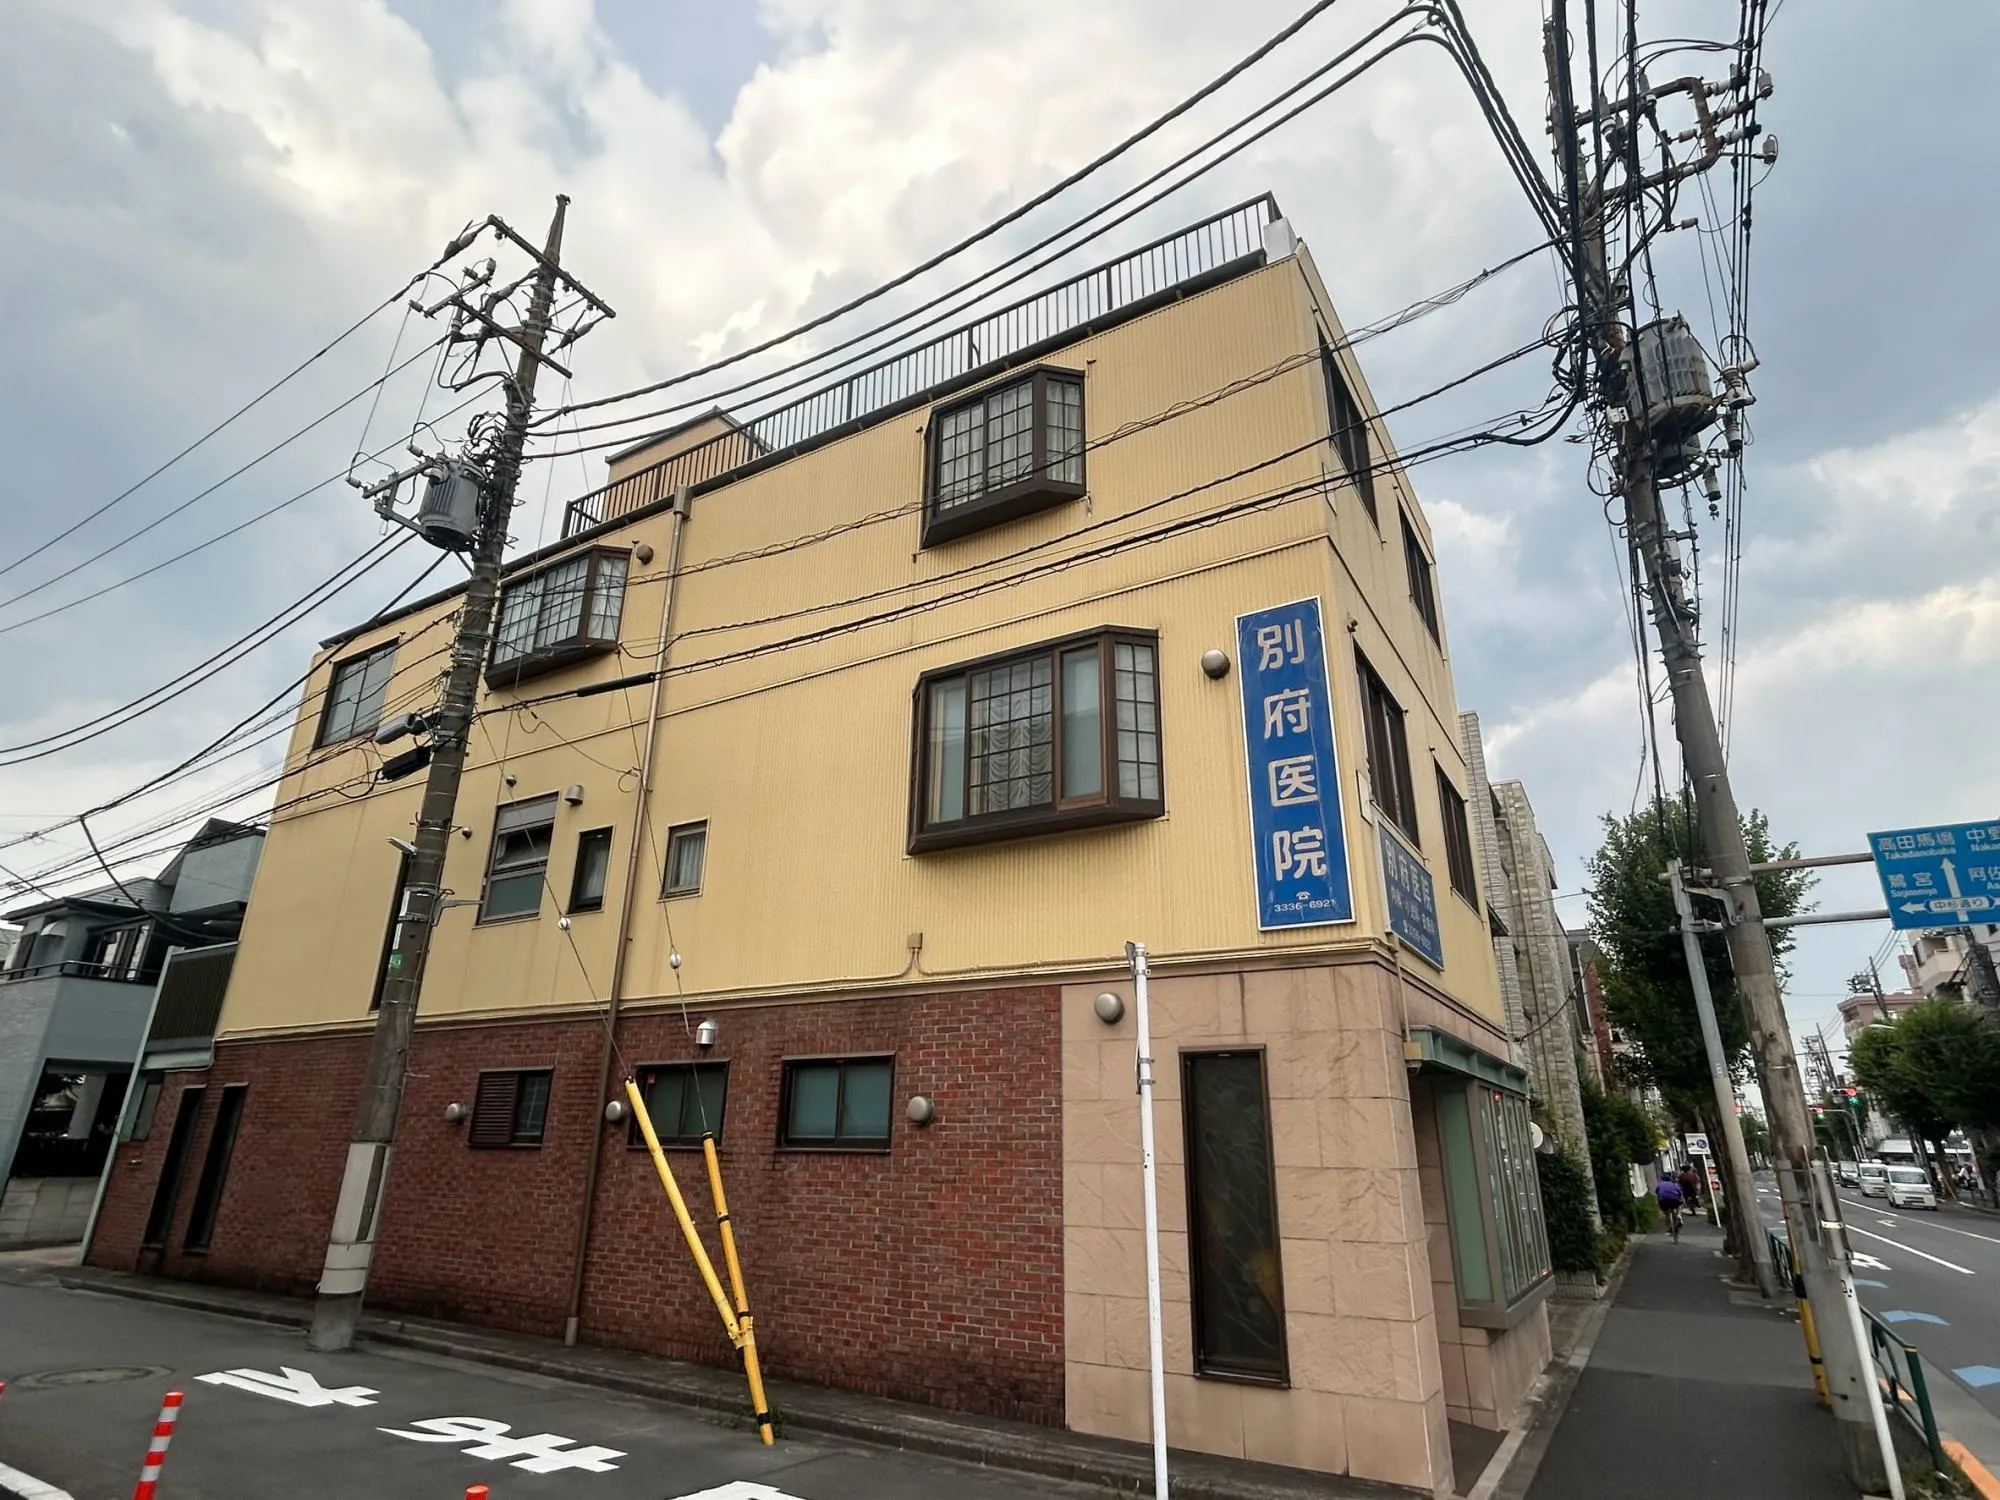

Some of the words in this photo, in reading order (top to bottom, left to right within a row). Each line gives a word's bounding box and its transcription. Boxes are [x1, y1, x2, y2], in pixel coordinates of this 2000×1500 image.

[1257, 618, 1327, 883] 別府医院
[1385, 839, 1433, 913] 別府医院
[1878, 831, 1956, 851] 高田馬場
